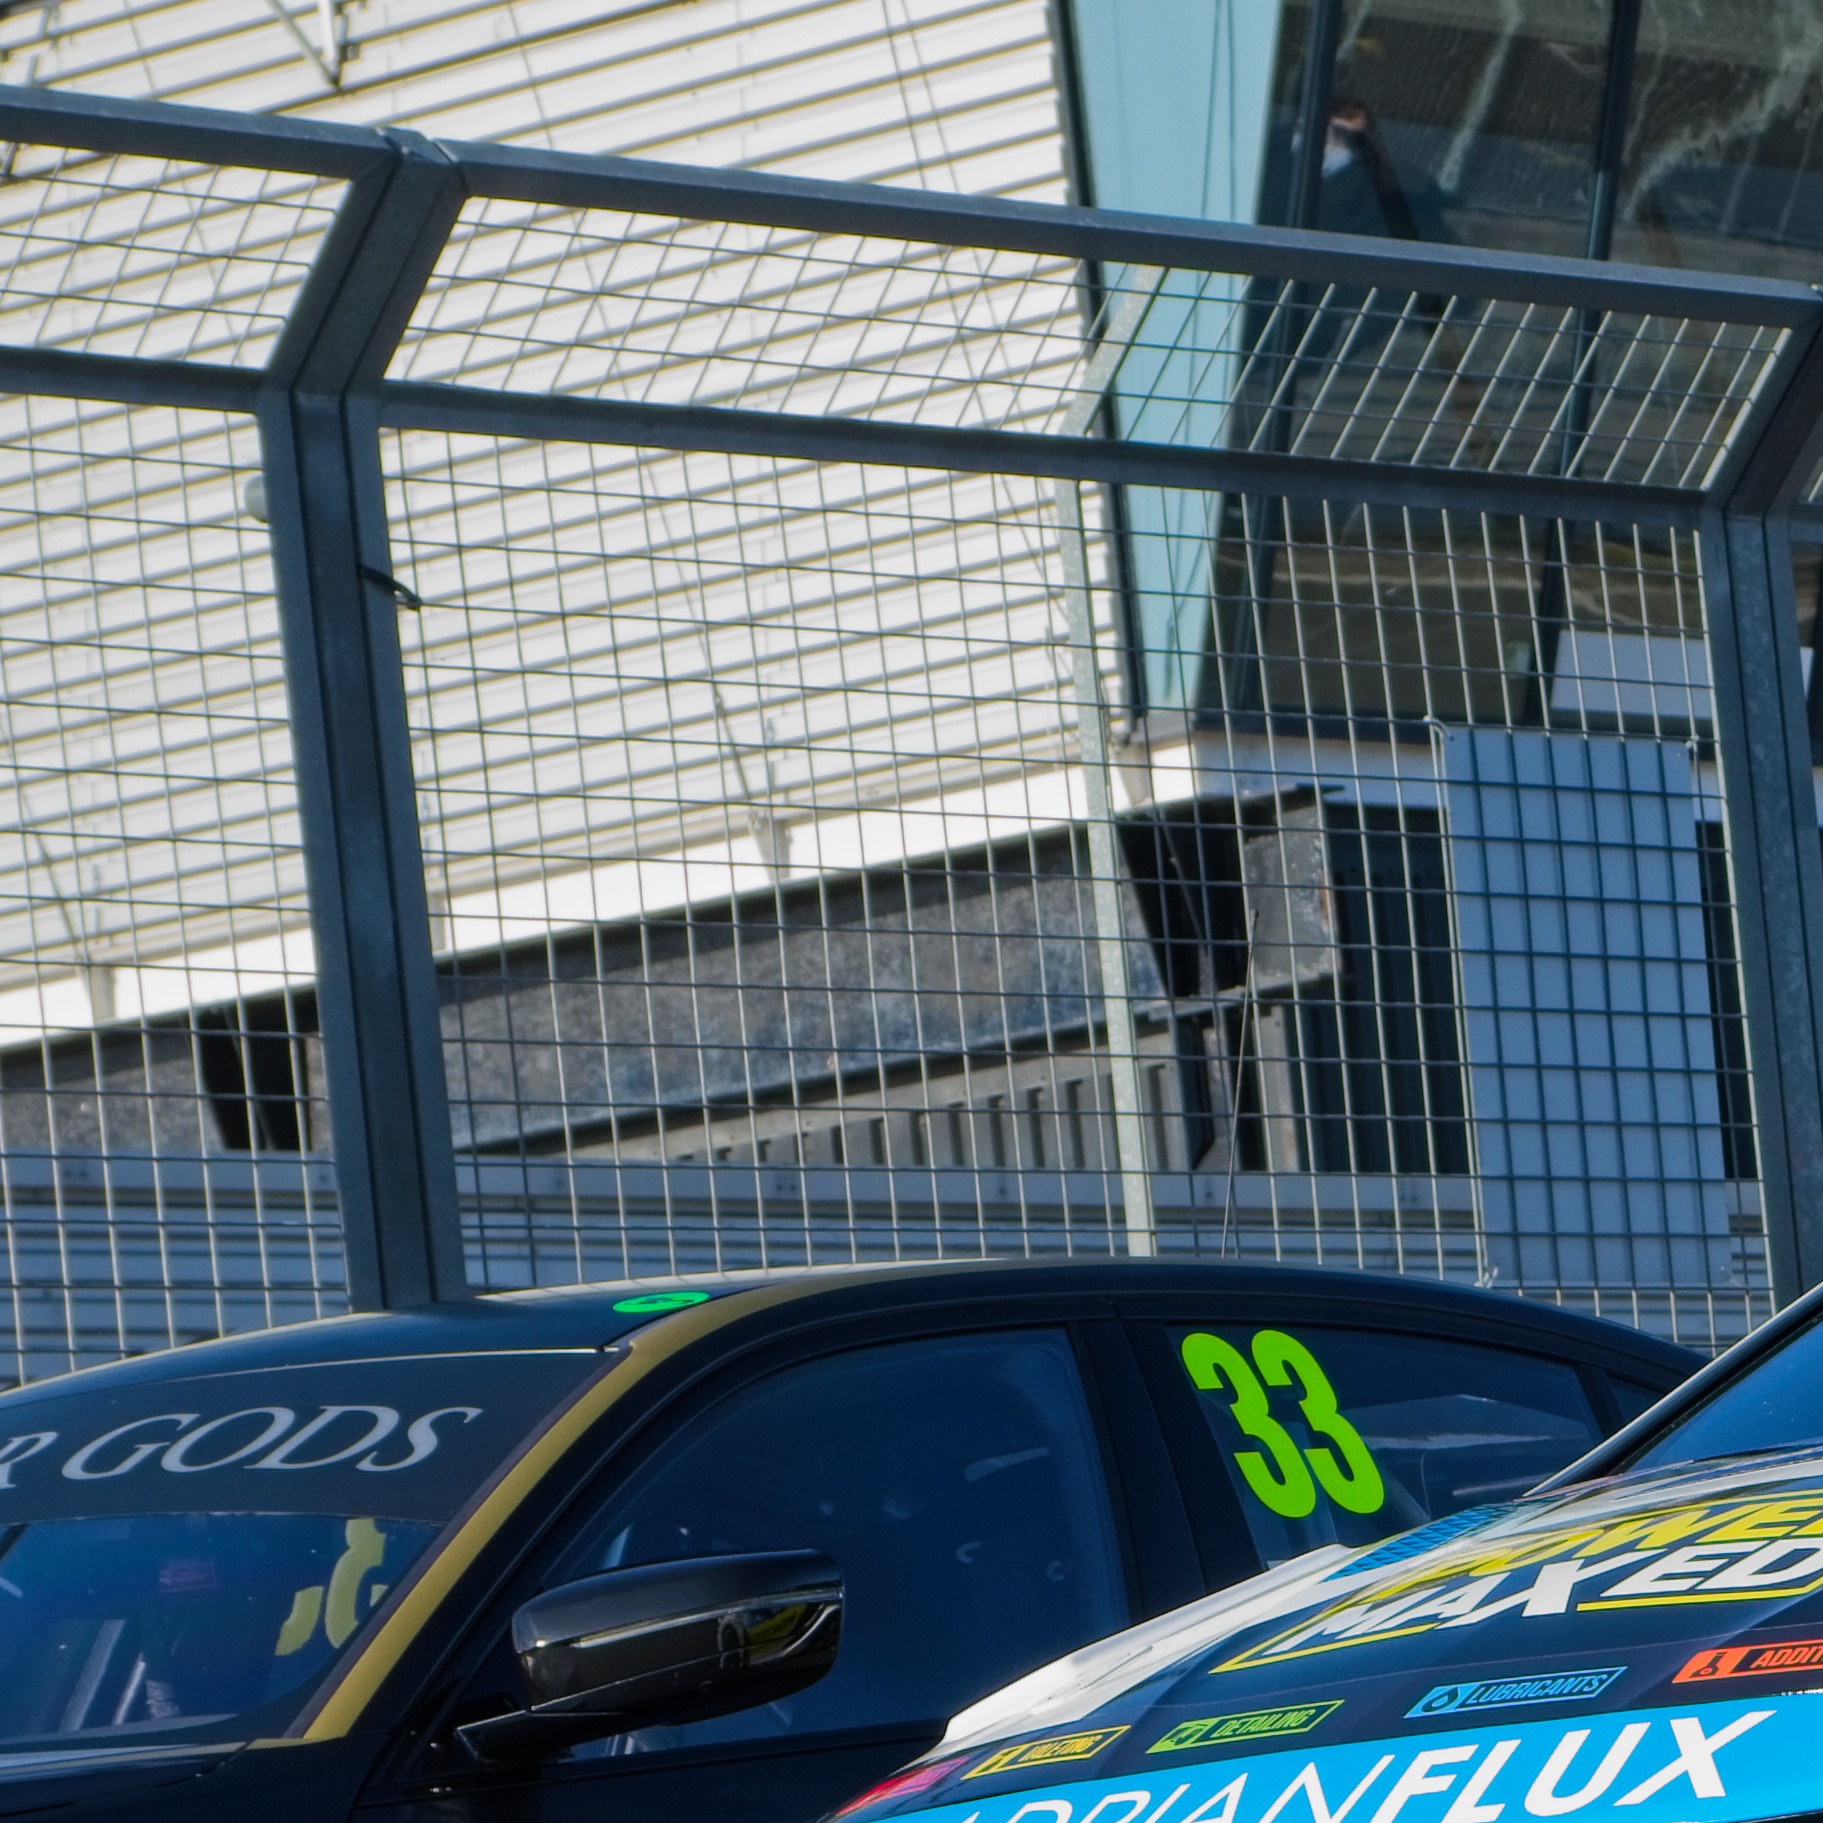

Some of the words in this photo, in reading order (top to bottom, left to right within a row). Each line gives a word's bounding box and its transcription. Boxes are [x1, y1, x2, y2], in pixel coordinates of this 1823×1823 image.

[61, 1405, 483, 1482] GODS
[1181, 1329, 1385, 1518] 33
[1467, 1673, 1607, 1705] LUBRICANTS
[1209, 1708, 1318, 1739] DETAILING
